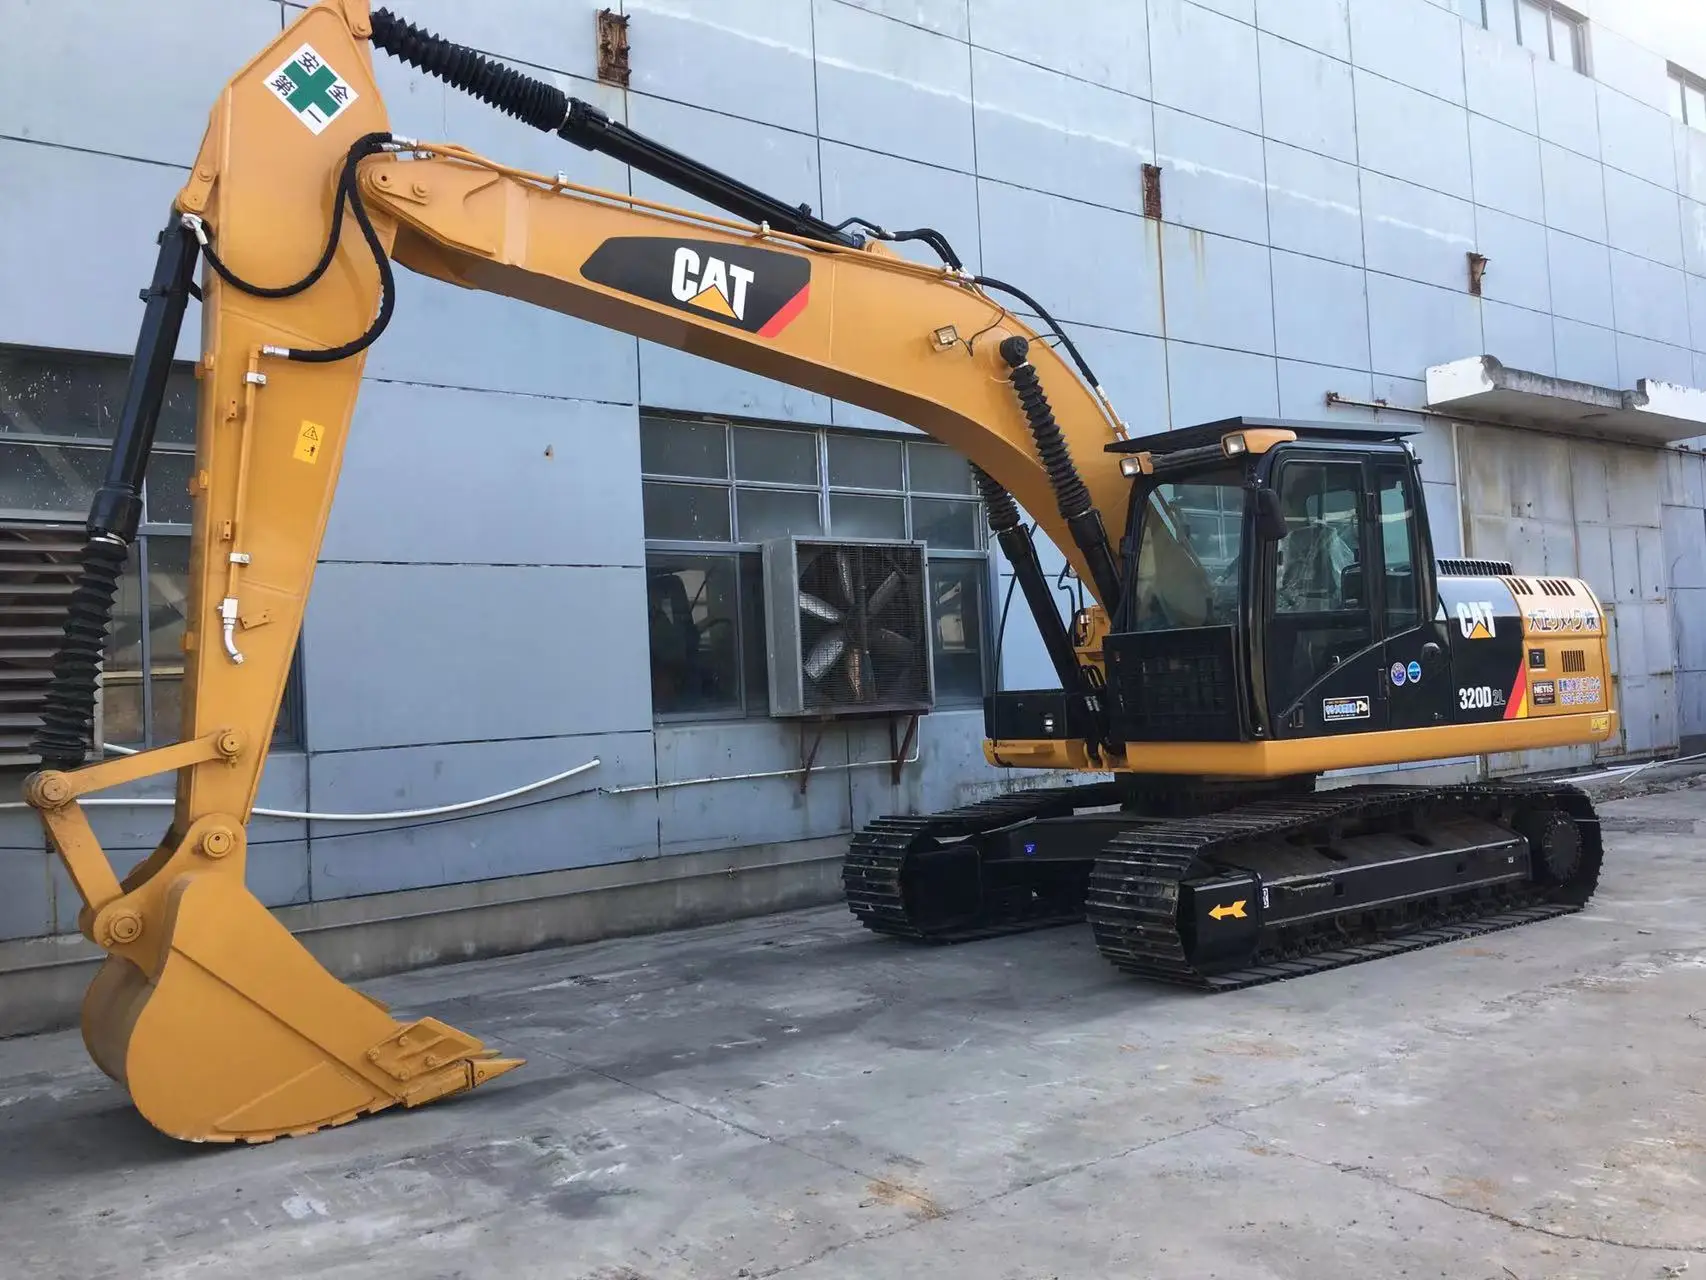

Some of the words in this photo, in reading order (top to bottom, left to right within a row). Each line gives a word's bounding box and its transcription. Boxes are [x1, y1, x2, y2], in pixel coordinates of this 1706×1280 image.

[671, 247, 755, 321] CAT
[1456, 601, 1496, 639] CAT
[1459, 686, 1492, 709] 320D
[1533, 684, 1554, 694] NETIS
